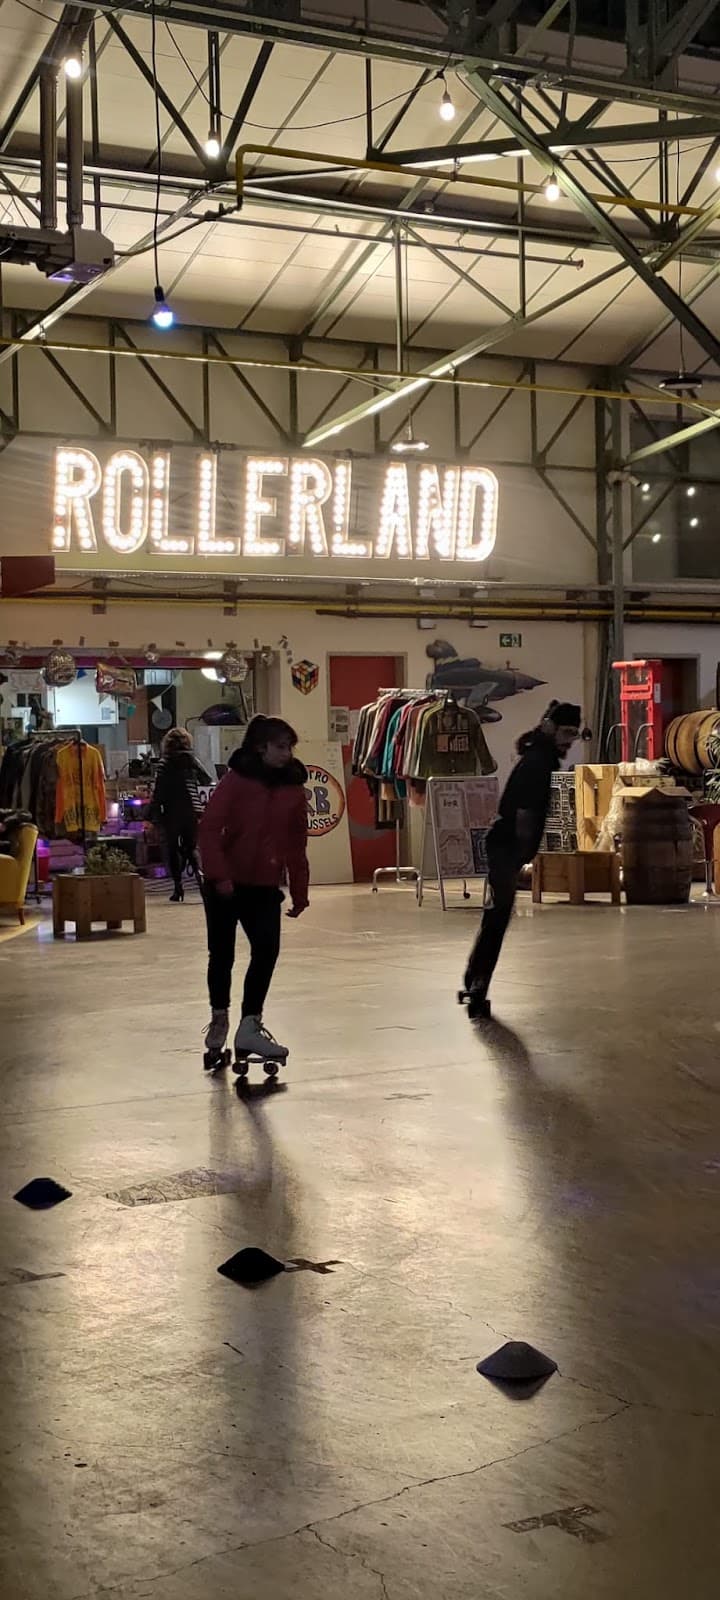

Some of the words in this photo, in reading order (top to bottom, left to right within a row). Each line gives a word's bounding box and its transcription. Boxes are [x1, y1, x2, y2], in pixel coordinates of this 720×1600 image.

[52, 446, 499, 561] ROLLERLAND
[308, 769, 329, 784] TRO
[306, 813, 339, 830] USSELS
